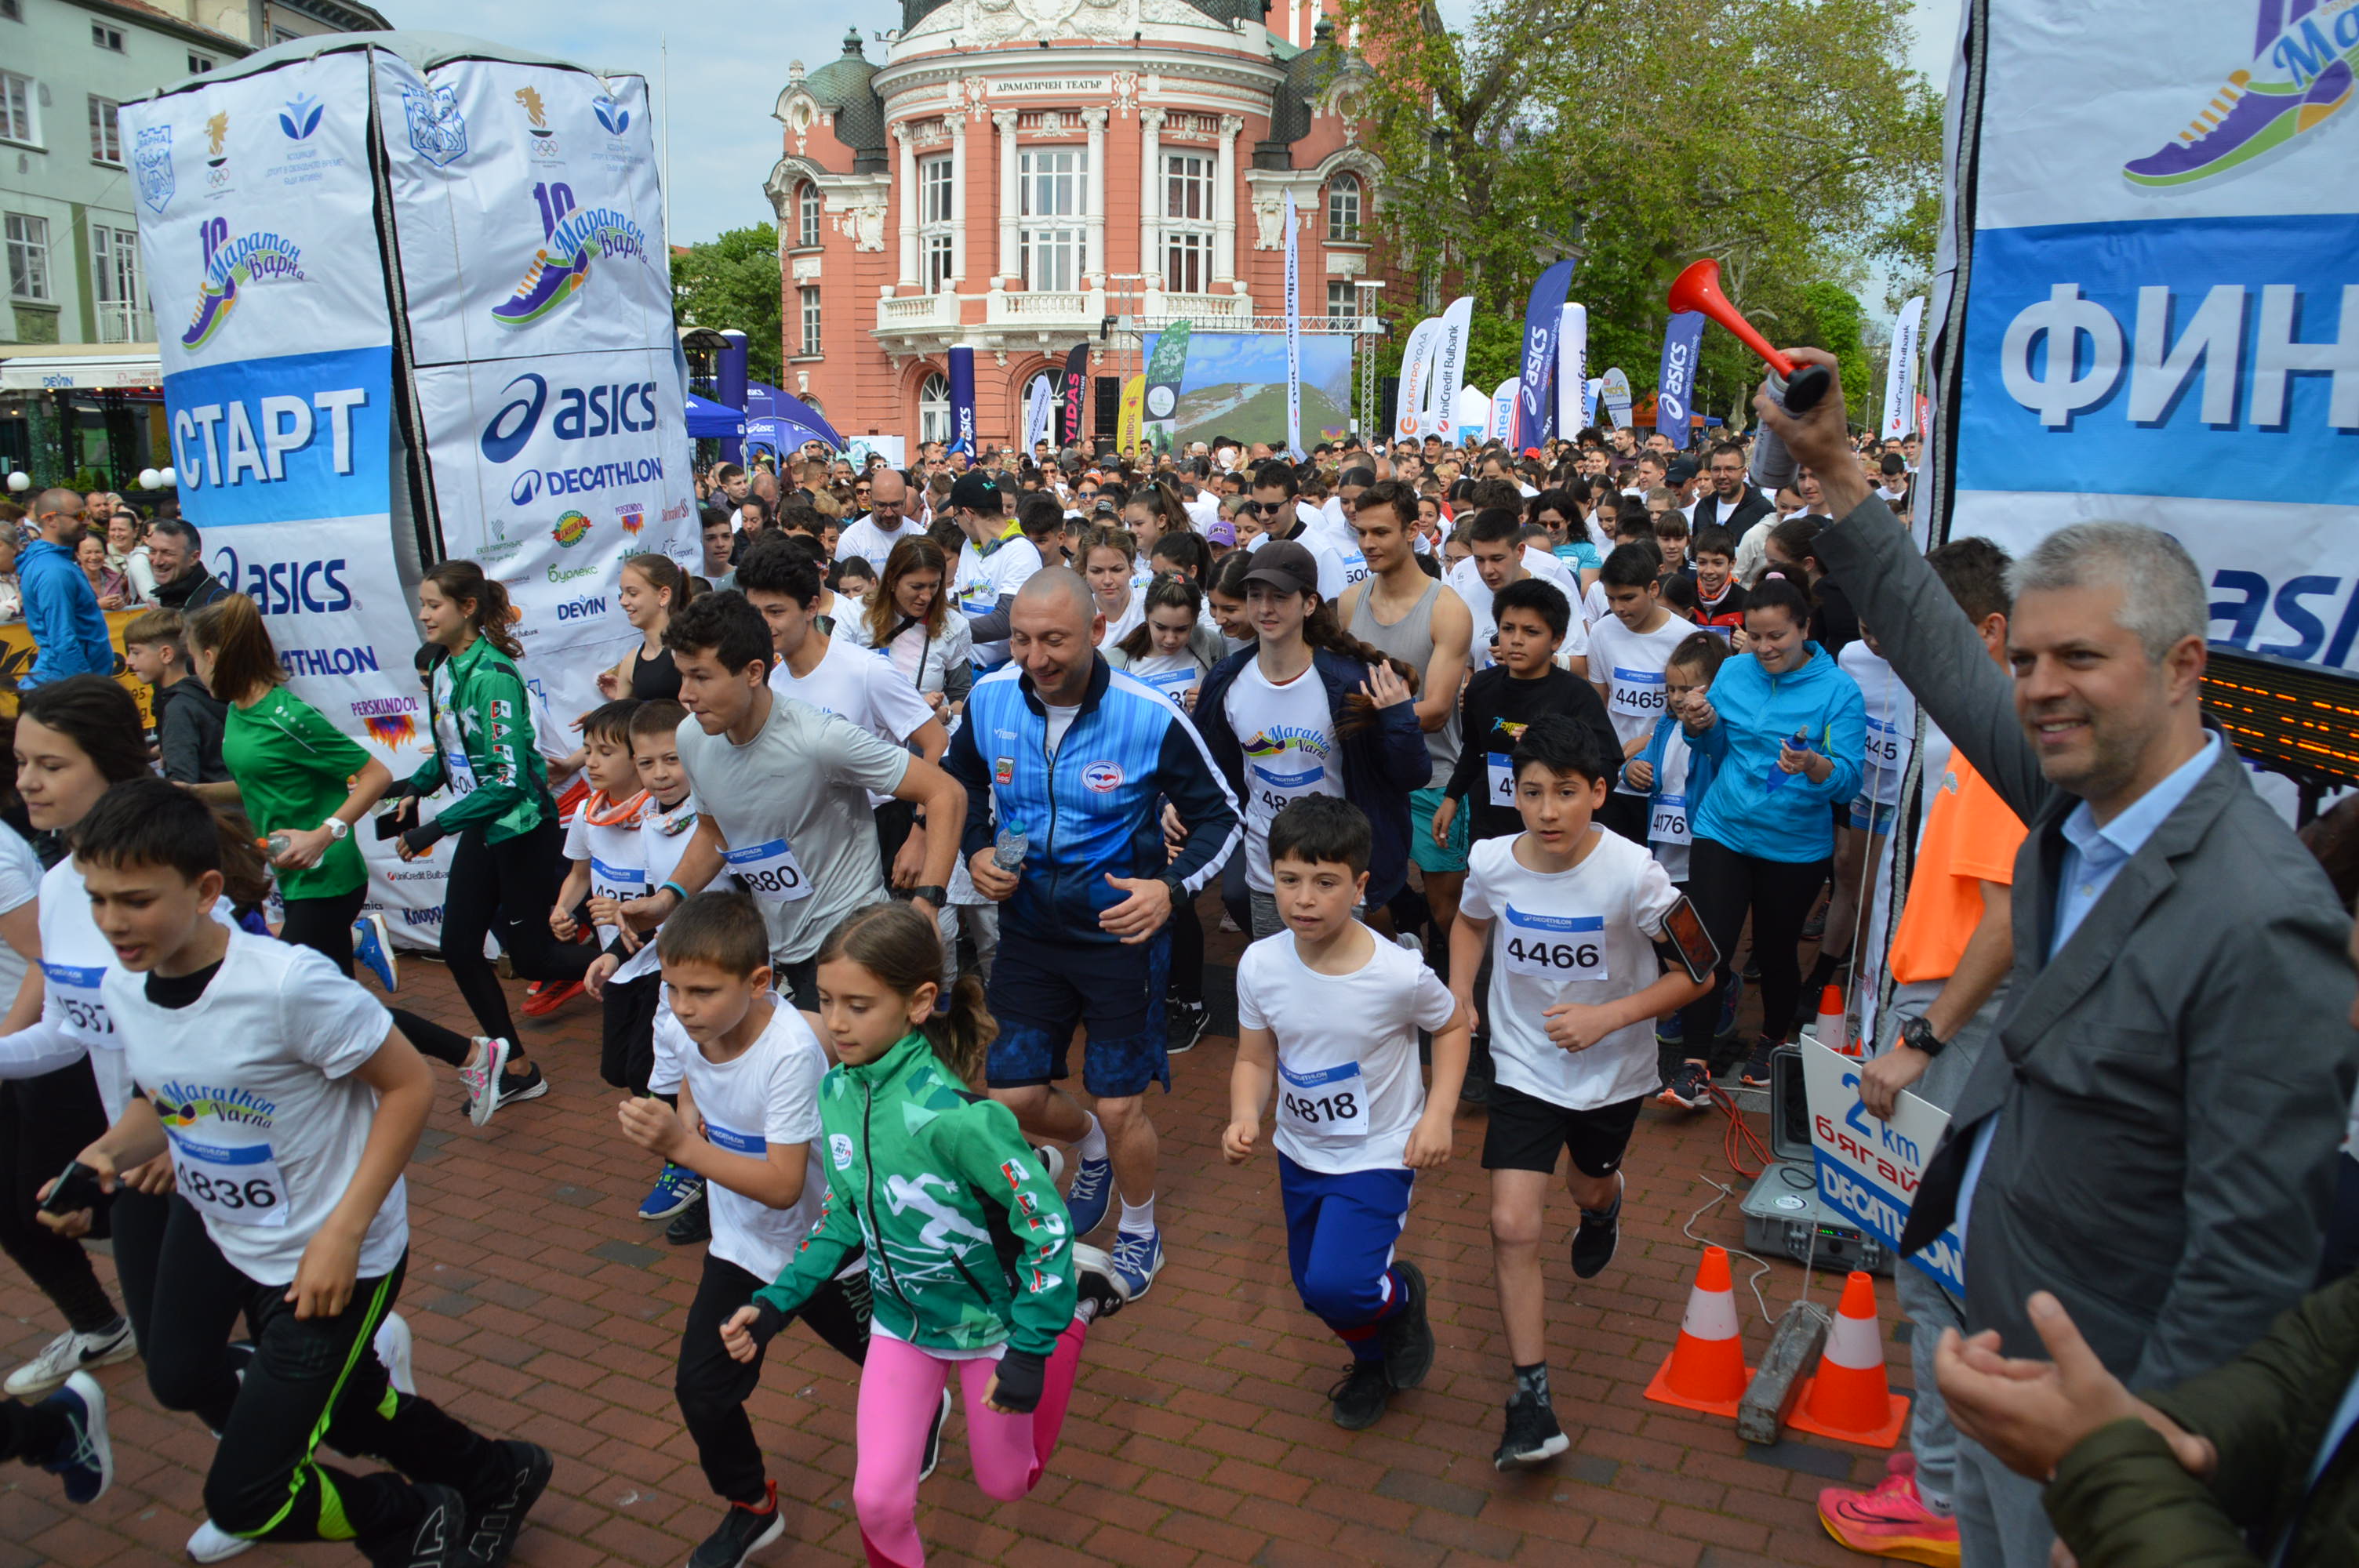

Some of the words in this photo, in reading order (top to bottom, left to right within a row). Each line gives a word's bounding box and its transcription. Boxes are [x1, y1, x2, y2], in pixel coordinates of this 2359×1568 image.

[997, 81, 1062, 92] ДРАМАТИЧЕН
[1066, 80, 1102, 89] ТЕАТЪР
[554, 208, 645, 264] Маратон
[597, 229, 648, 265] Варна
[209, 231, 301, 288] Маратон
[245, 253, 304, 281] Варна
[1445, 325, 1459, 369] Bulbank
[2001, 283, 2359, 431] ФИН
[43, 375, 74, 387] DEVIN
[1439, 372, 1453, 419] UniCredit
[174, 388, 369, 490] СТАРТ
[1125, 413, 1136, 447] KINDOL
[547, 457, 663, 496] DECATHLON
[558, 597, 606, 620] DEVIN
[2208, 569, 2359, 669] asi
[280, 645, 380, 677] ATHLON
[351, 696, 420, 717] PERSKINDOL
[1616, 688, 1664, 709] 4465
[1269, 724, 1331, 752] Marathon
[1296, 739, 1326, 760] Varna
[1865, 735, 1897, 760] 445
[1263, 790, 1287, 812] 48
[1653, 814, 1685, 834] 4176
[394, 871, 425, 880] UniCredit
[427, 869, 452, 880] Bulba
[745, 866, 799, 892] 880
[403, 904, 445, 926] Knopp
[1532, 916, 1572, 925] DECATHLON
[1507, 938, 1600, 969] 4466
[162, 1080, 277, 1117] Marathon
[1285, 1092, 1358, 1123] 4818
[209, 1102, 272, 1129] Varna
[1816, 1115, 1921, 1194] бягай
[178, 1161, 277, 1210] 4836
[1822, 1163, 1965, 1287] DECATHON
